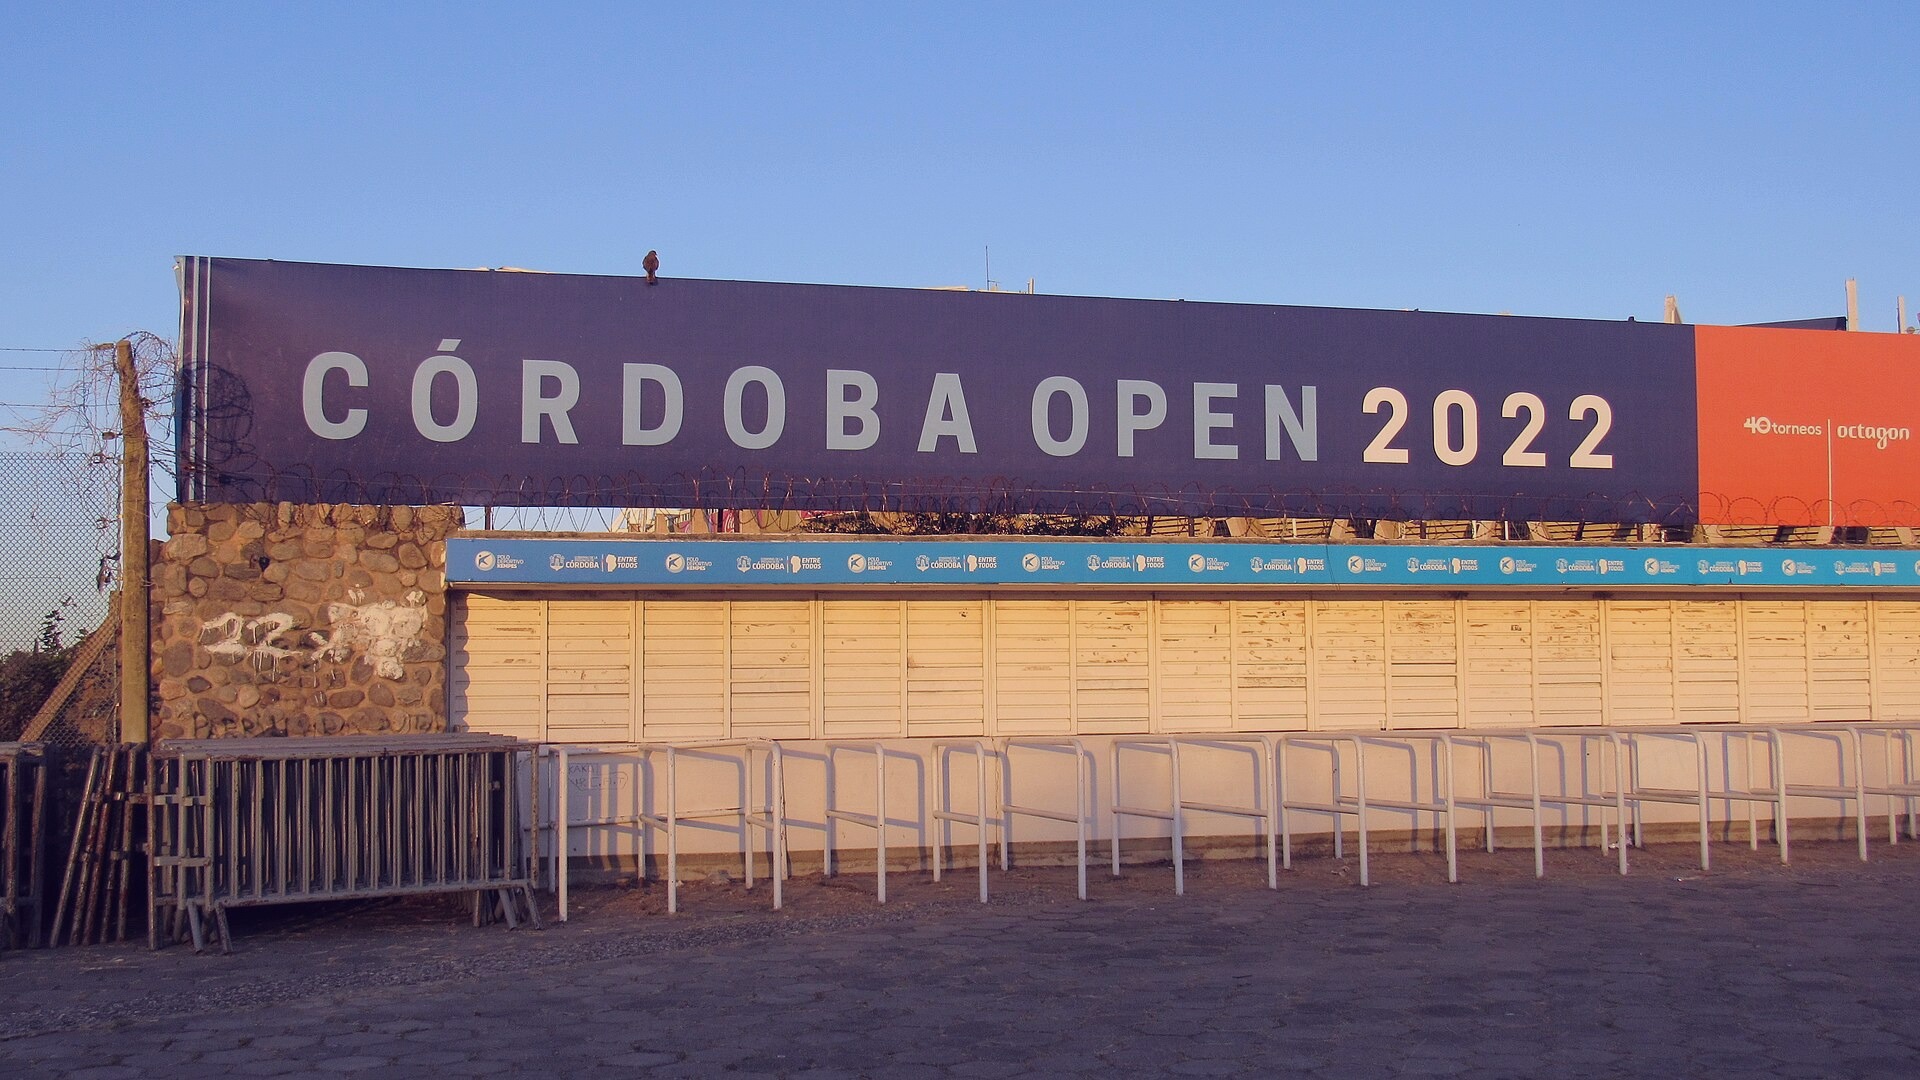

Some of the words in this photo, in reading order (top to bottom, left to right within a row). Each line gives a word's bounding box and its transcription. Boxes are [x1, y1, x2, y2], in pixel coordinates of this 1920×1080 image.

[303, 339, 977, 453] CÓRDOBA
[1032, 376, 1317, 461] OPEN
[1363, 387, 1612, 468] 2022
[1771, 421, 1822, 435] torneos
[1837, 423, 1910, 449] octagon
[565, 560, 599, 569] CÓRDOBA
[752, 561, 785, 570] CÓRDOBA
[930, 560, 962, 569] CÓRDOBA
[1101, 560, 1131, 568] CÓRDOBA
[1264, 562, 1292, 570] CÓRDOBA
